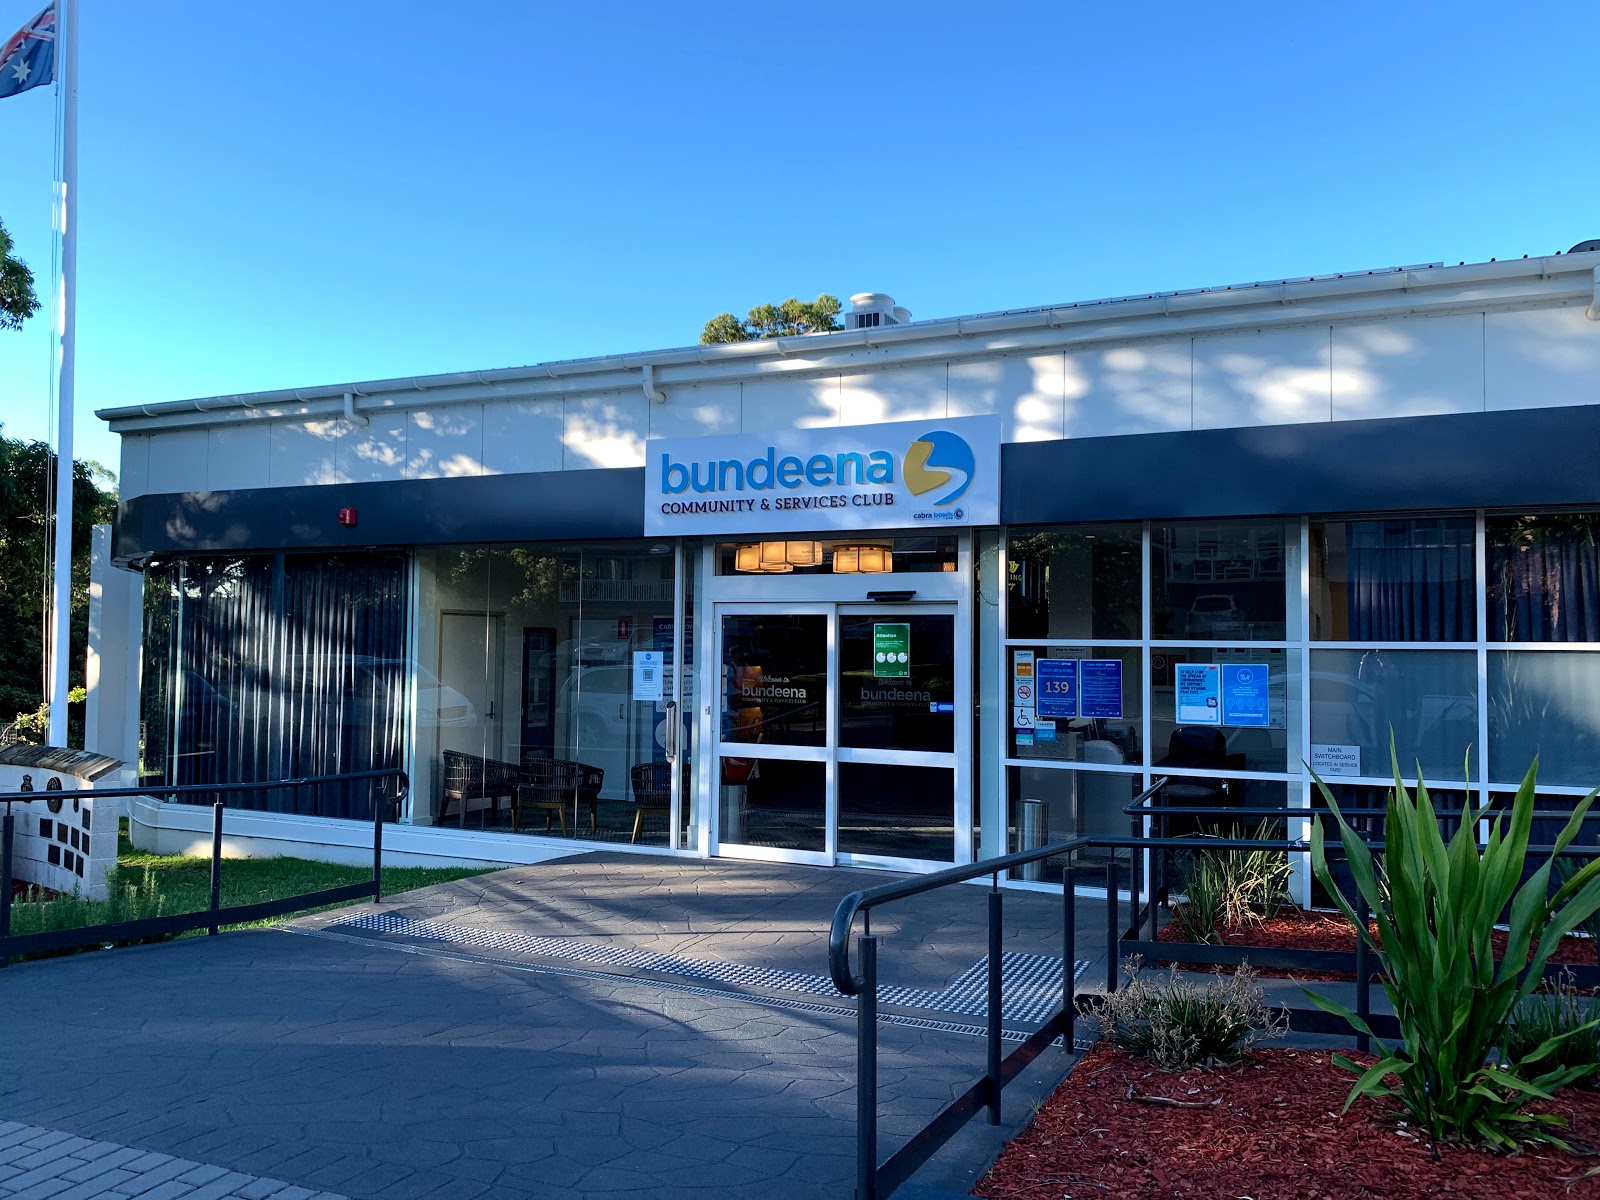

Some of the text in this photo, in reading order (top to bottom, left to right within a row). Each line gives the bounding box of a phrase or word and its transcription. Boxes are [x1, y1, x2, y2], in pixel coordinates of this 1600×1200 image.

[661, 446, 894, 494] bundeena
[661, 492, 895, 514] COMMUNITY & SERVICES CLUB
[913, 511, 932, 519] cabra
[742, 684, 807, 698] bundeena
[861, 687, 931, 701] bundeena
[1045, 681, 1069, 694] 139
[1314, 753, 1356, 761] SWITCHBOARD
